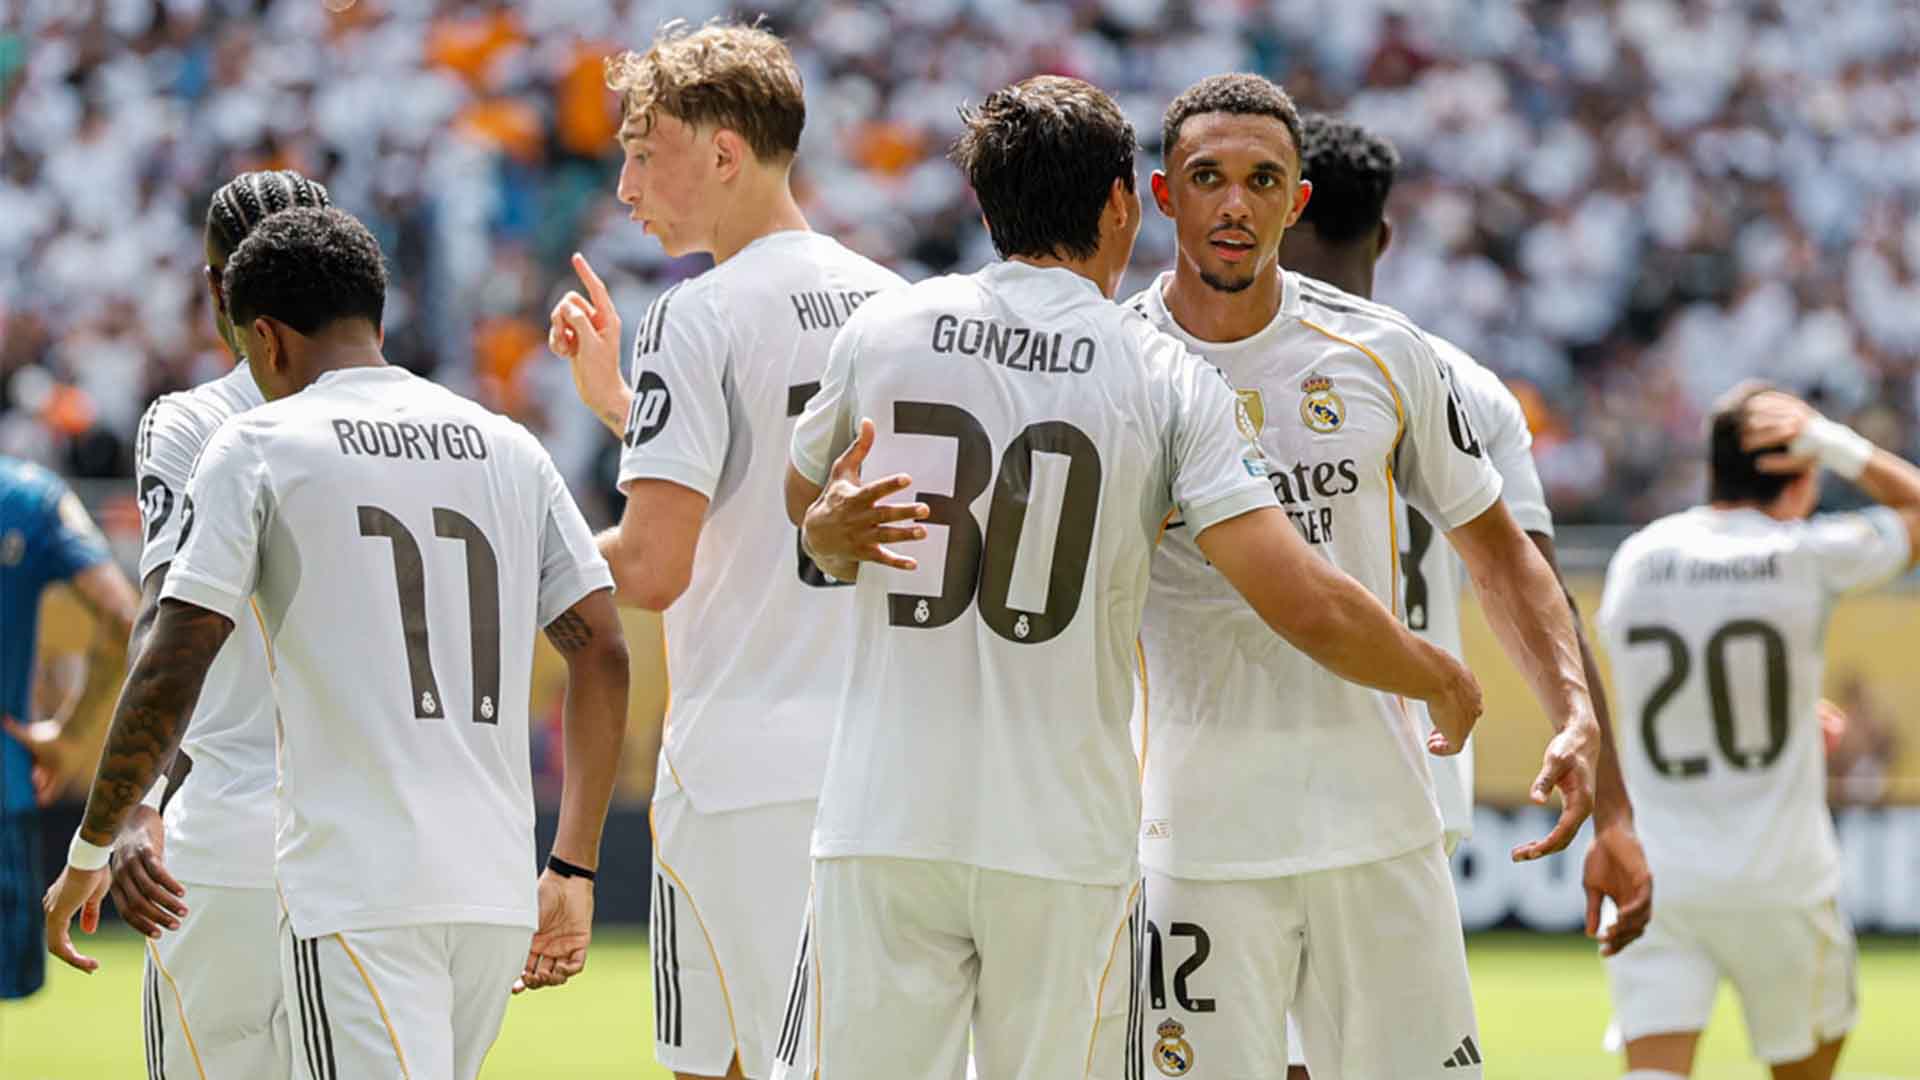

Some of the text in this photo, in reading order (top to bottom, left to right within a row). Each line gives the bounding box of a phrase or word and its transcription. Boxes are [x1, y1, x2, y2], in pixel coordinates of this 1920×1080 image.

[791, 291, 880, 331] HUIJS
[932, 314, 1096, 374] GONZALO
[333, 419, 488, 461] RODRYGO
[888, 401, 1102, 645] 30
[357, 504, 499, 726] 11
[1627, 619, 1789, 777] 20
[1147, 921, 1217, 1013] 12
